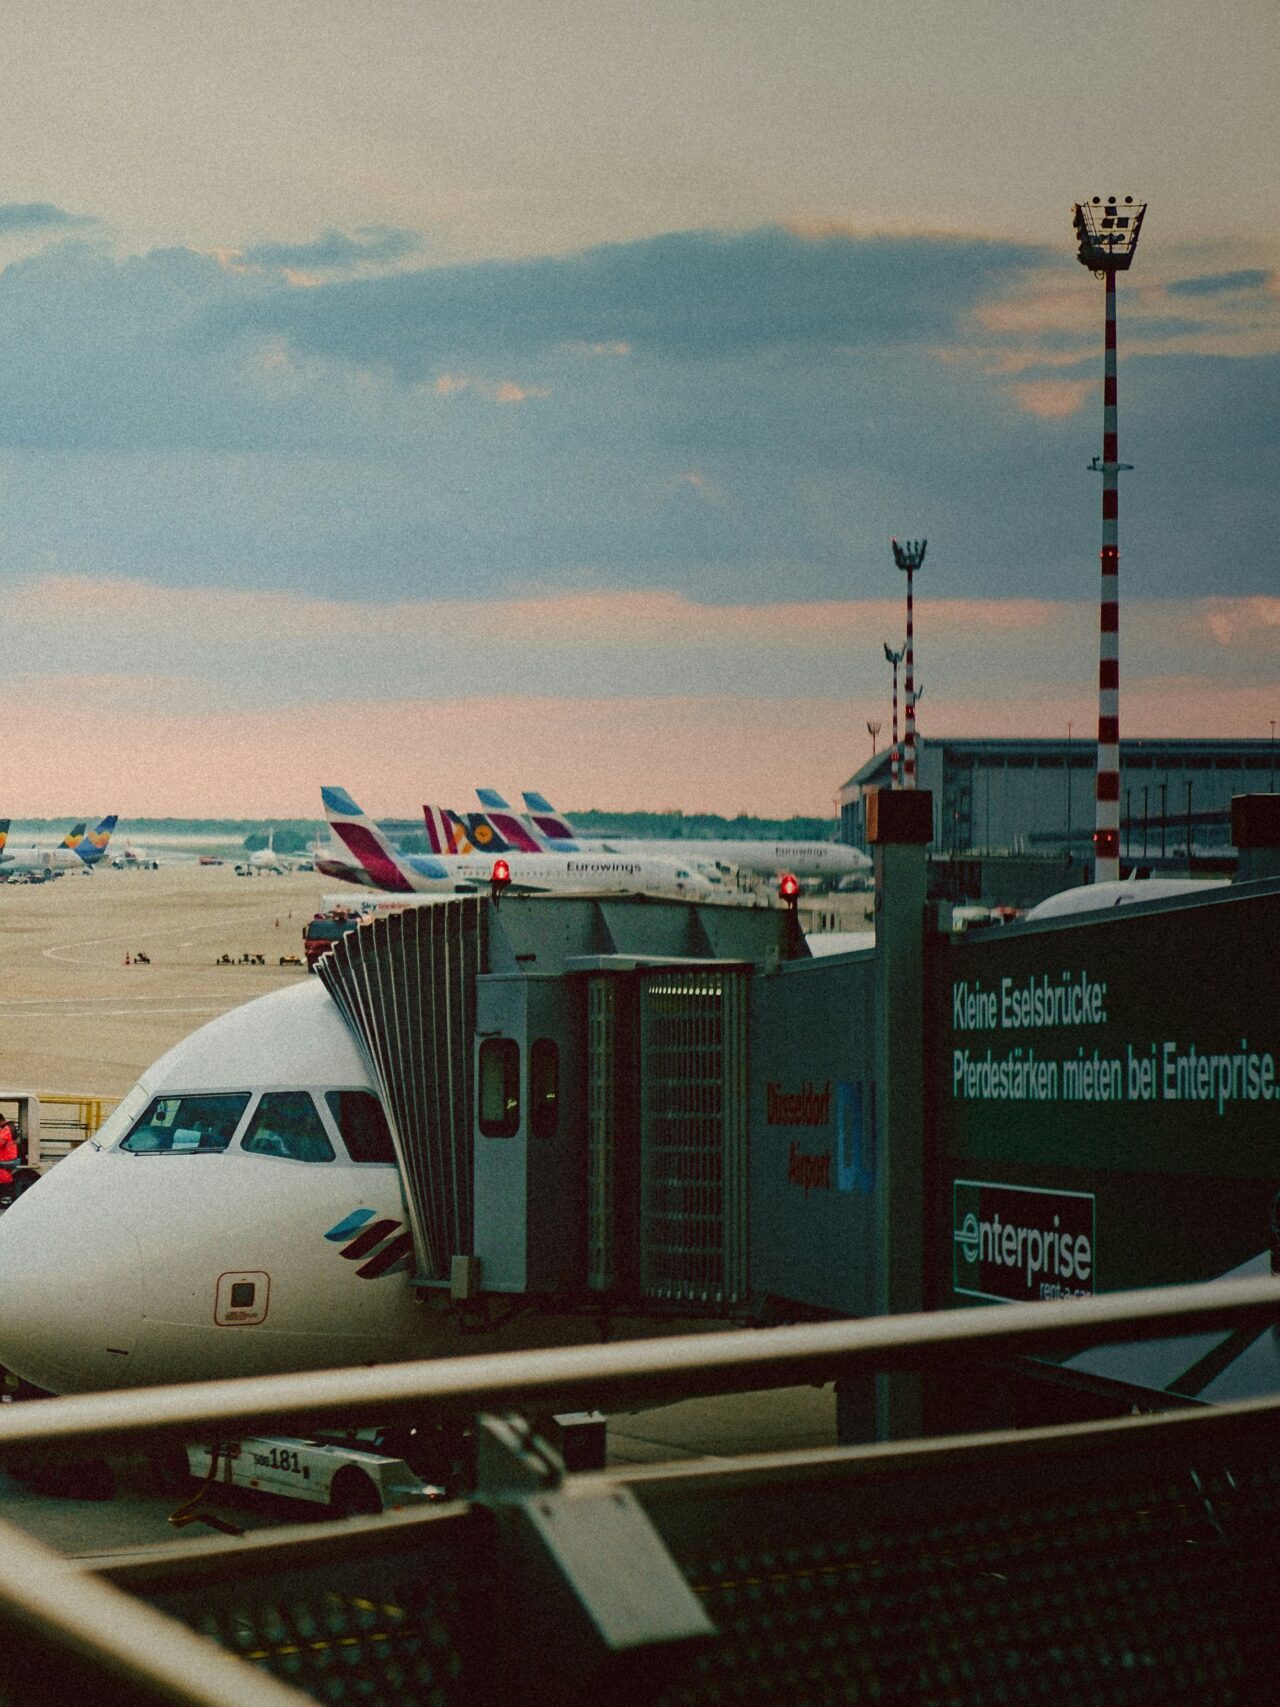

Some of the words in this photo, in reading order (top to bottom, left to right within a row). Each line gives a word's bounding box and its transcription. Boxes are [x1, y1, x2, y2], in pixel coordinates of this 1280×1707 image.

[566, 861, 642, 874] Eurowings
[775, 847, 828, 858] Eurowings
[953, 981, 998, 1030] Kleine
[1001, 970, 1107, 1030] Eselsbrücke:
[953, 1048, 1058, 1099] Pferdestärken
[1063, 1046, 1122, 1101] mieten
[1128, 1042, 1157, 1101] bei
[1163, 1039, 1280, 1115] Enterprise.
[955, 1212, 1092, 1288] enterprise
[269, 1447, 301, 1474] 181
